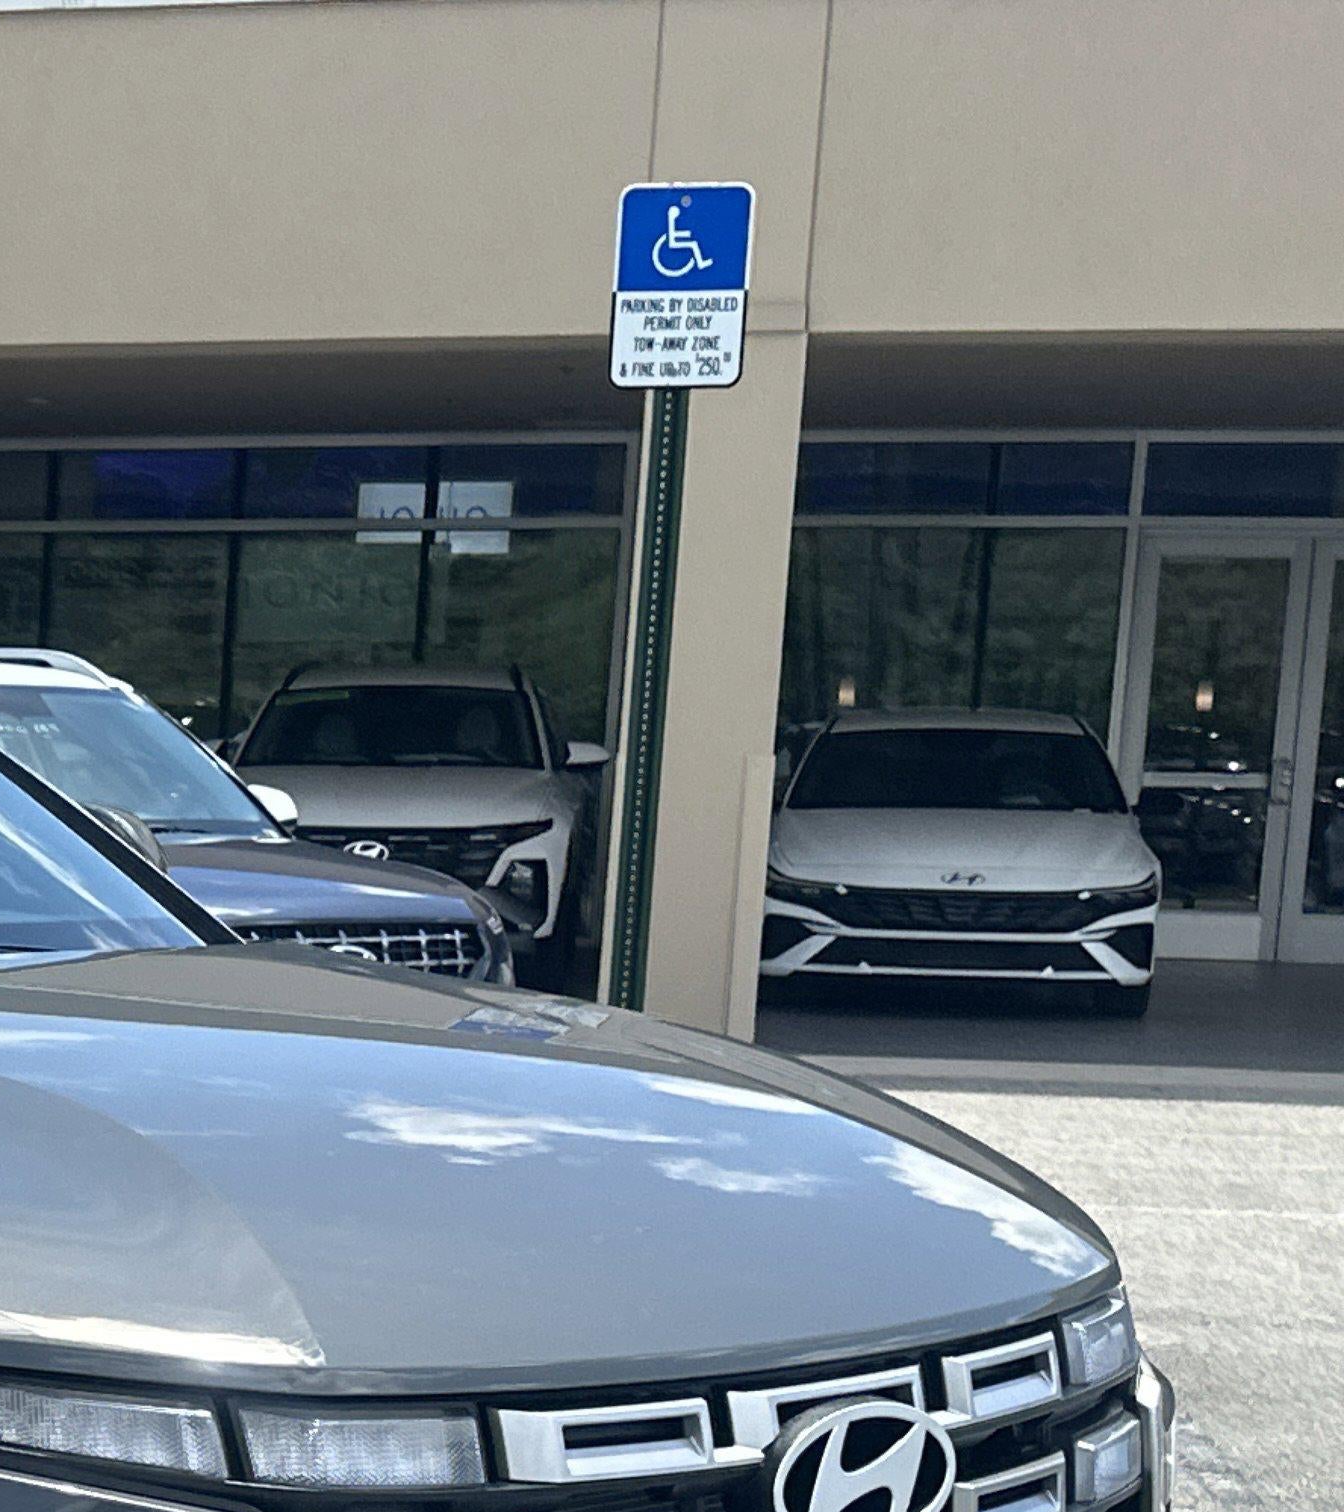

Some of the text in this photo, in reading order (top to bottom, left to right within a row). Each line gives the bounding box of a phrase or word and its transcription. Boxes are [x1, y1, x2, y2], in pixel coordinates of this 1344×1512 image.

[620, 296, 738, 313] PARKING BY DISABLED
[643, 315, 712, 331] PERMIT ONLY
[633, 335, 720, 352] TOW-AWAY ZONE
[631, 361, 654, 377] FINE
